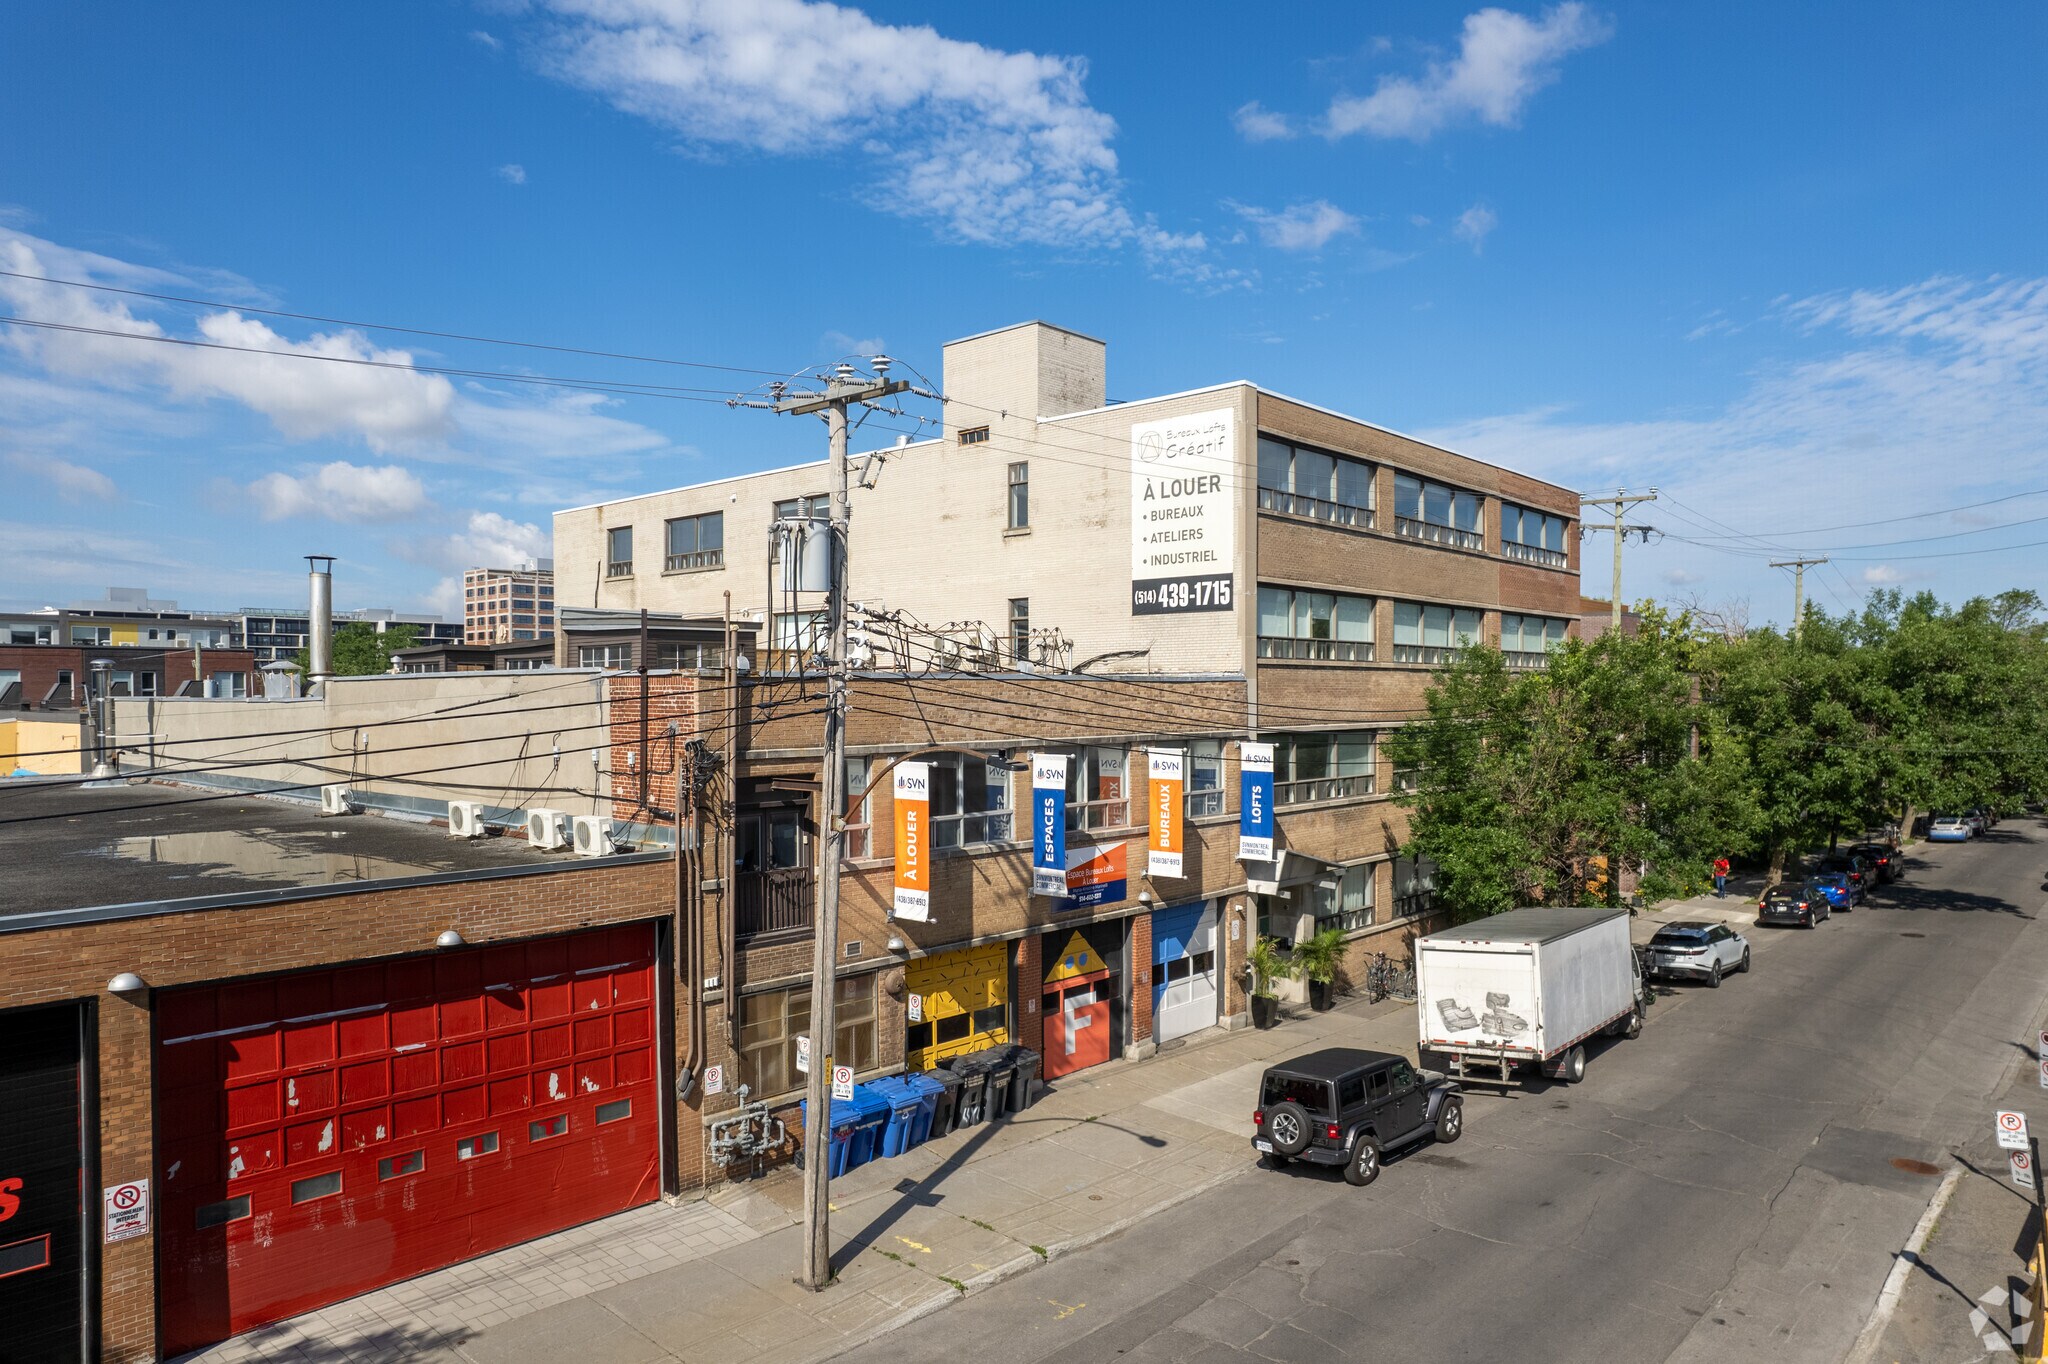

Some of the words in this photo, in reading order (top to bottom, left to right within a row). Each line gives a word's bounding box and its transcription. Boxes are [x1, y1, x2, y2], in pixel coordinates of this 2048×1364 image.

[1166, 435, 1226, 459] Créatif
[1143, 477, 1156, 502] À
[1160, 474, 1222, 499] LOUER
[1150, 504, 1204, 522] BUREAUX
[1150, 527, 1204, 545] ATELIERS
[1150, 549, 1219, 567] INDUSTRIEL
[1134, 588, 1157, 605] (514)
[1157, 579, 1232, 609] 439-1715
[1161, 760, 1179, 771] SVN
[1253, 754, 1271, 764] SVN
[1045, 768, 1064, 780] SVN
[906, 777, 926, 790] SVN
[1251, 785, 1263, 824] LOFTS
[1160, 783, 1171, 848] BUREAUX
[906, 810, 918, 867] LOUER
[1044, 797, 1055, 863] ESPACES
[904, 869, 917, 881] À
[1067, 870, 1085, 880] Espace
[1085, 867, 1104, 876] Bureaux
[1063, 990, 1097, 1056] F
[109, 1205, 145, 1220] STATIONNEMENT
[115, 1212, 140, 1223] INTERDIT
